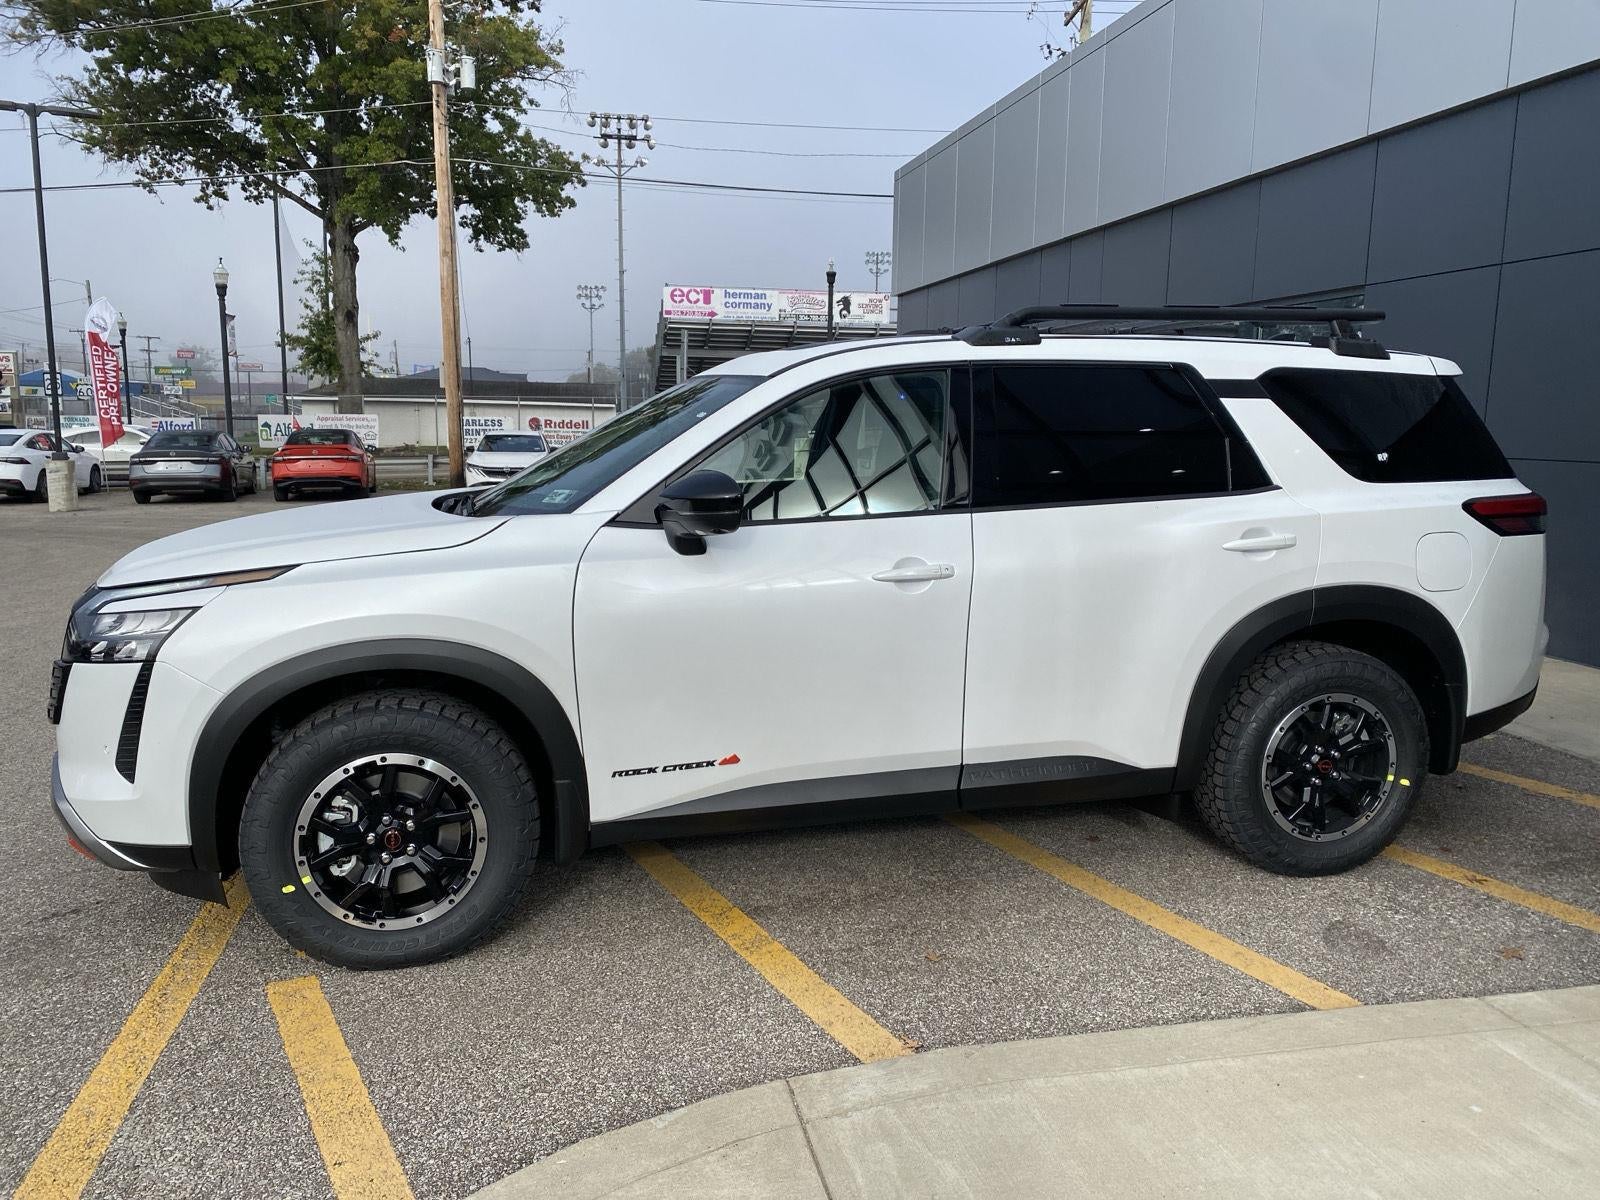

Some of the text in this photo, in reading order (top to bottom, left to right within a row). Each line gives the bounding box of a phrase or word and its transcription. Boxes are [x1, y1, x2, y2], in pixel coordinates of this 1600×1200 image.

[724, 289, 767, 299] herman
[724, 301, 773, 311] cormany
[91, 345, 111, 419] CERTIFIED
[104, 344, 121, 426] PRE-OWNE
[157, 420, 194, 432] Alford
[543, 418, 589, 429] Riddell
[611, 759, 717, 778] ROCK CREEK
